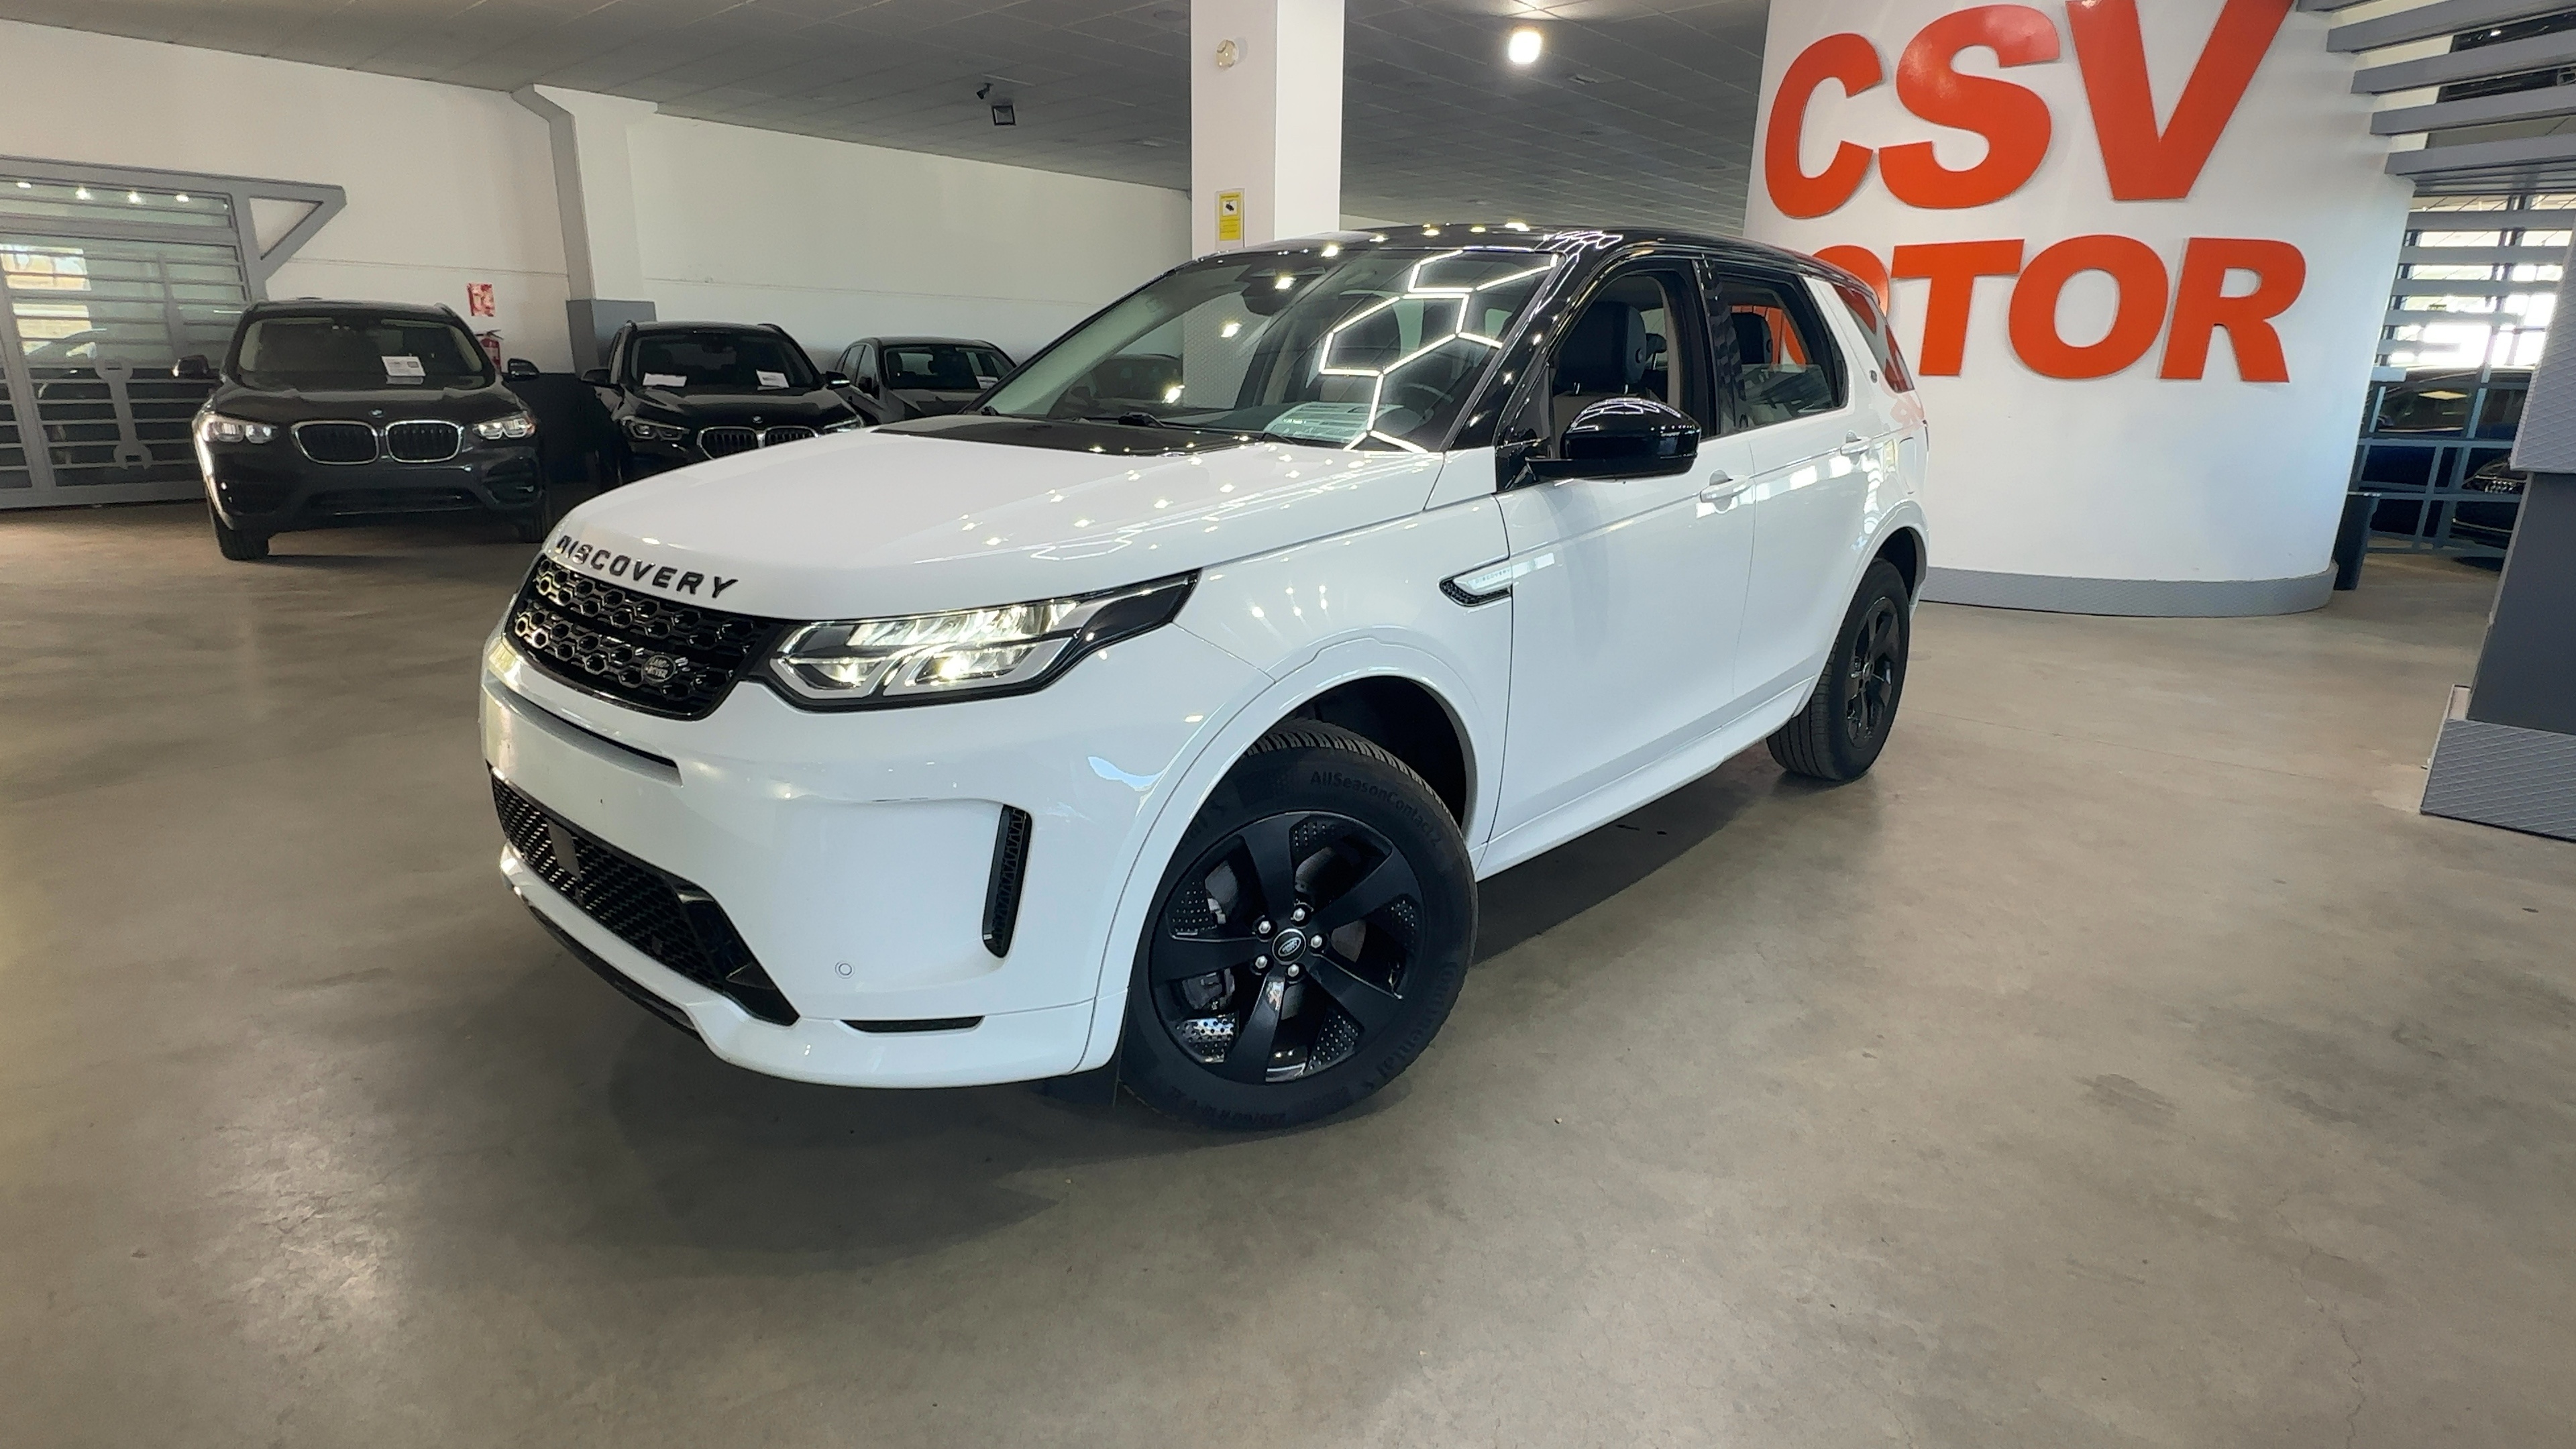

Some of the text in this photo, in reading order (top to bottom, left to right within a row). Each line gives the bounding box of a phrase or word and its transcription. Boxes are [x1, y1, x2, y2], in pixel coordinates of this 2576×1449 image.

[1765, 0, 2291, 219] CSV
[1808, 234, 2306, 384] TOR
[555, 535, 739, 598] DISCOVERY
